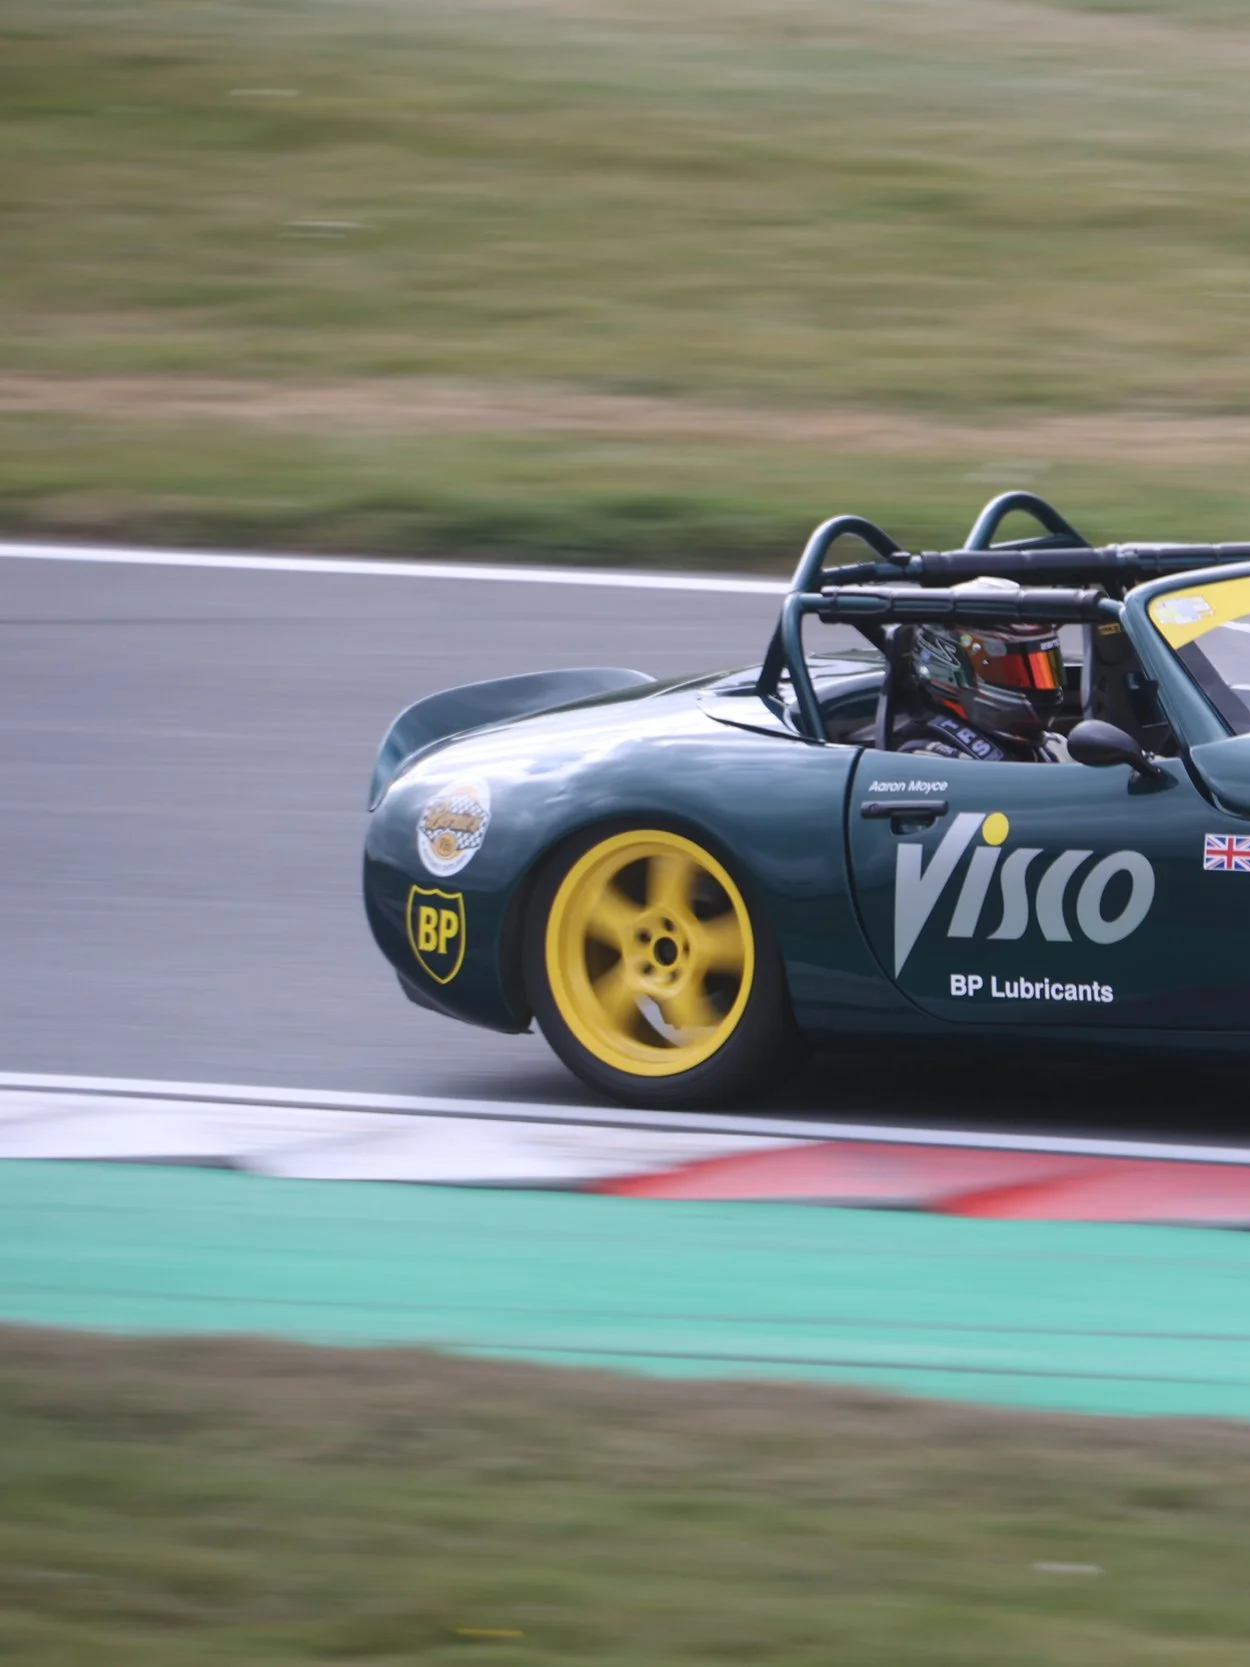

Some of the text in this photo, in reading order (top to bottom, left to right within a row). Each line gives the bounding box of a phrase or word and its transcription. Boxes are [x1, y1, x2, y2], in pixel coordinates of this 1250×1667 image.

[868, 780, 948, 795] Aaron Moyce
[418, 905, 459, 955] BP
[950, 974, 1114, 1003] BP Lubricants
